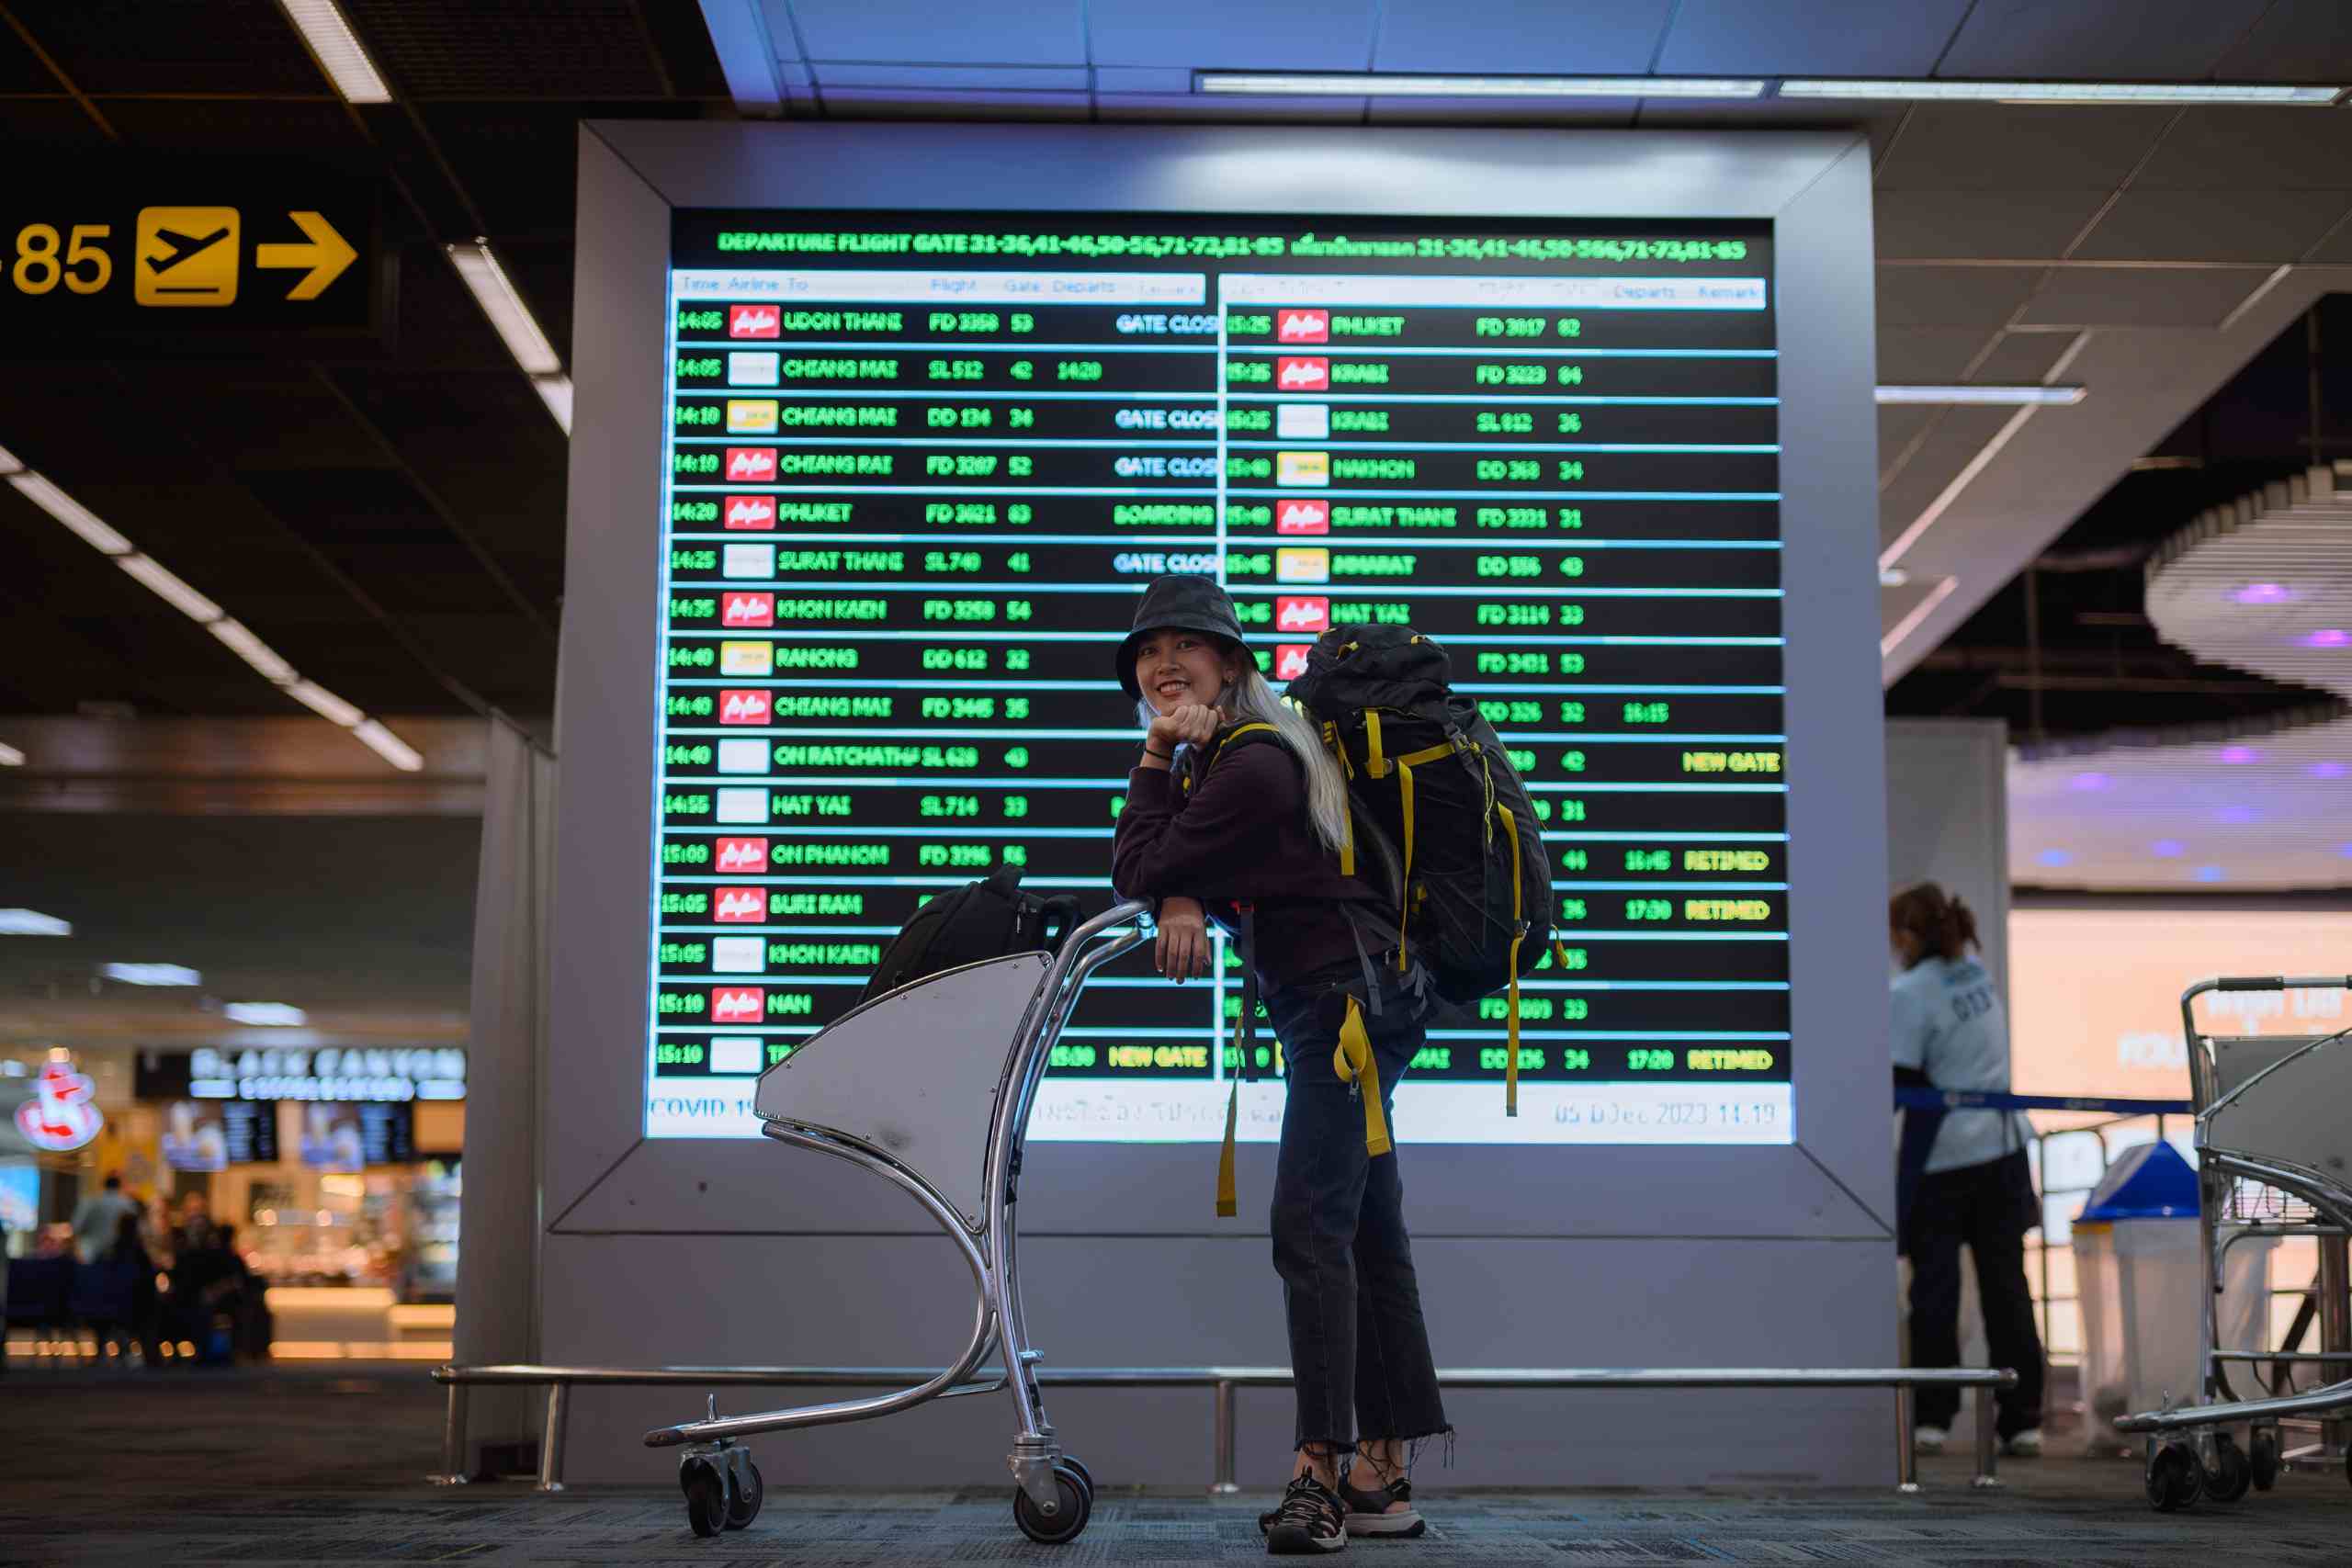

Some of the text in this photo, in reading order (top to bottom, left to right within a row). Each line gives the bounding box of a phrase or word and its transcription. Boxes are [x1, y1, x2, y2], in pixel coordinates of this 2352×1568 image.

[718, 233, 836, 252] DEPARTURE
[837, 233, 912, 252] FLIGHT
[913, 234, 970, 253] GATE
[784, 312, 841, 331] UDON
[930, 313, 957, 332] FD
[1116, 315, 1167, 333] GATE
[1476, 317, 1505, 336] FD
[783, 360, 858, 378] CHIANG
[1476, 365, 1505, 384] FD
[782, 407, 857, 426] CHIANG
[1115, 410, 1167, 428] GATE
[781, 456, 856, 474] CHIANG
[927, 456, 956, 475] FD
[1114, 457, 1166, 477] GATE
[926, 504, 955, 523] FD
[1477, 508, 1506, 527] FD
[1114, 553, 1166, 572] GATE
[924, 601, 953, 620] FD
[1477, 604, 1507, 625] FD
[1478, 653, 1507, 672] FD
[775, 697, 851, 716] CHIANG
[922, 698, 952, 717] FD
[920, 845, 949, 865] FD
[767, 994, 811, 1014] NAN
[650, 1098, 725, 1118] COVID
